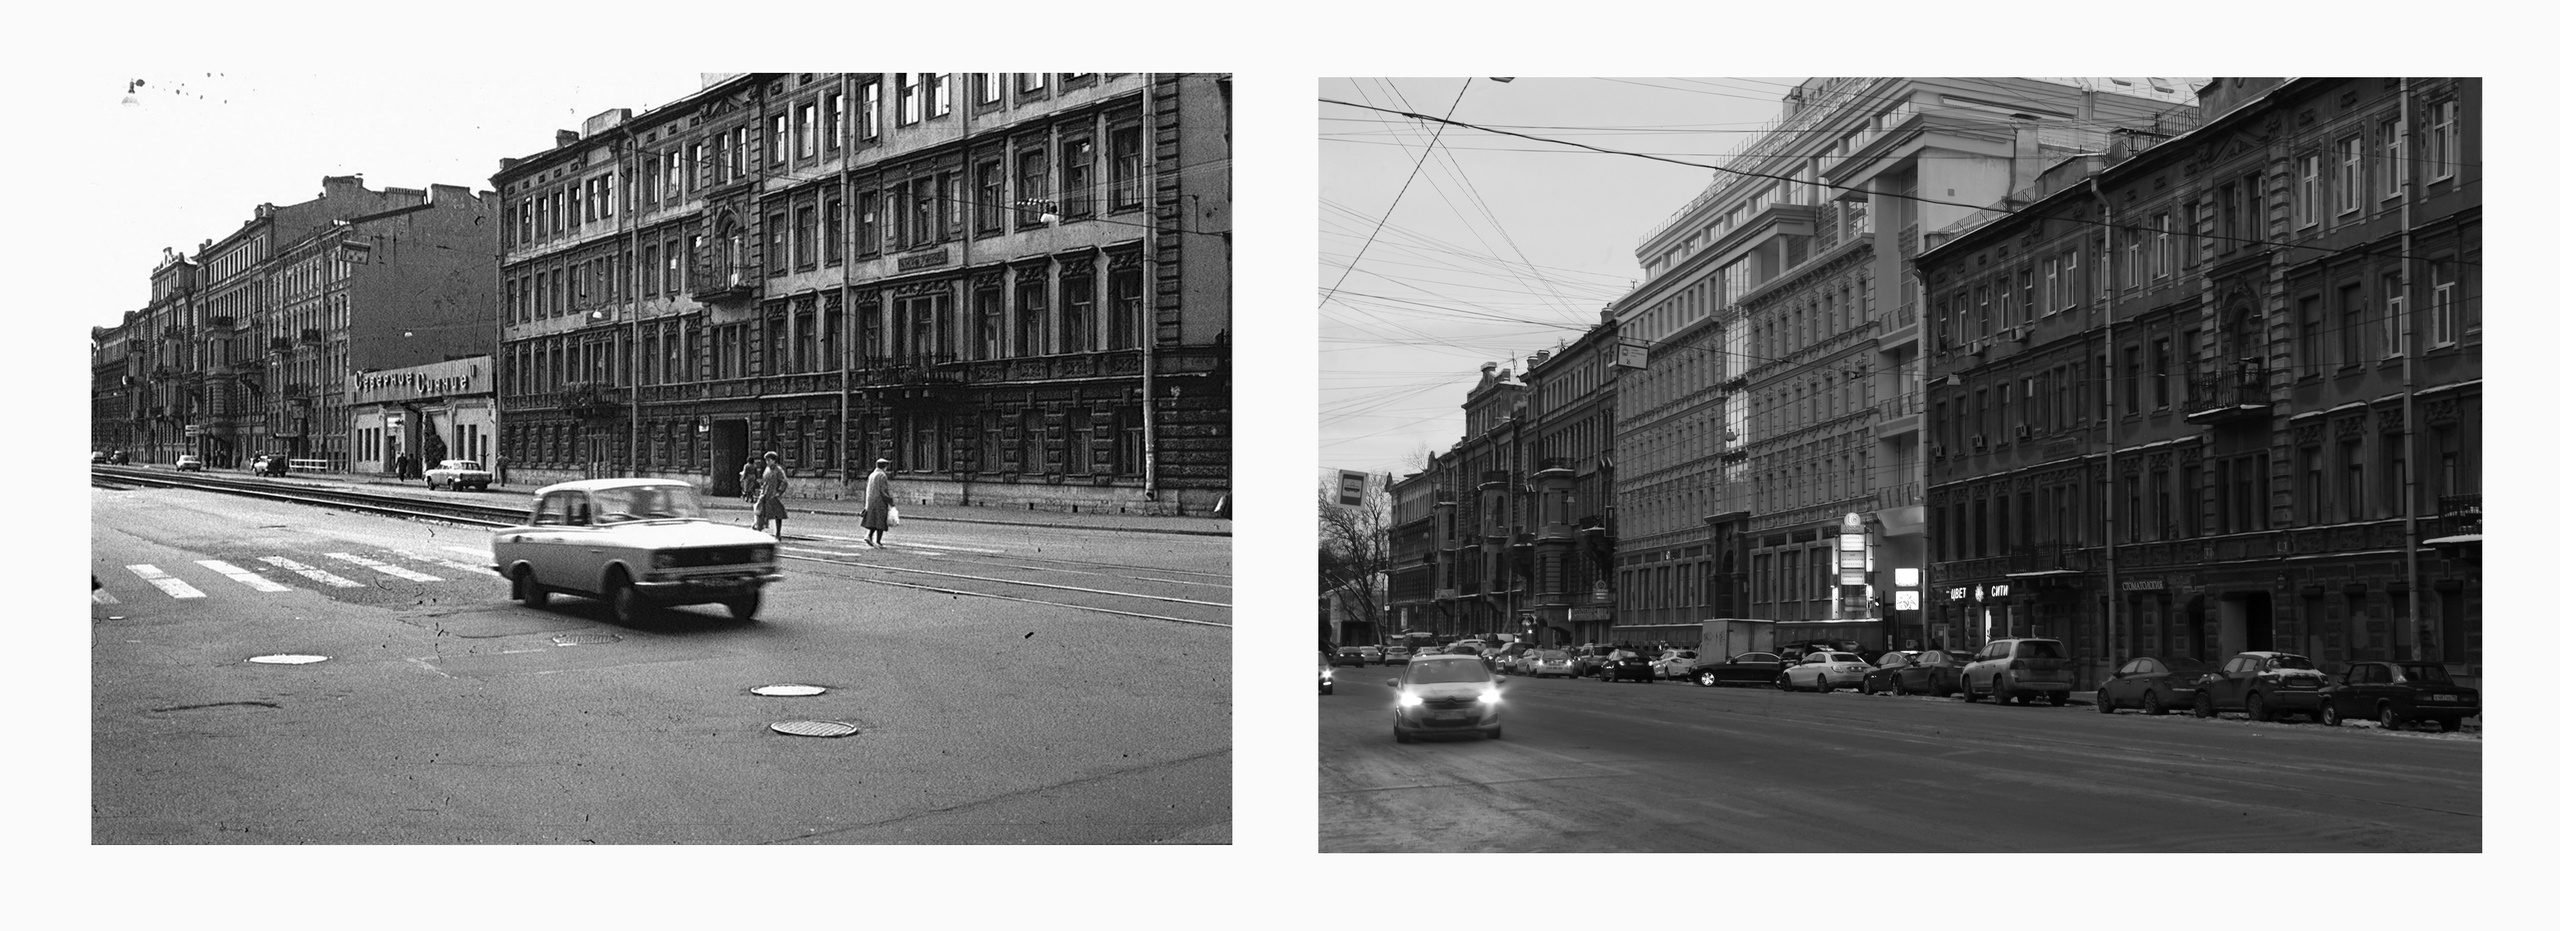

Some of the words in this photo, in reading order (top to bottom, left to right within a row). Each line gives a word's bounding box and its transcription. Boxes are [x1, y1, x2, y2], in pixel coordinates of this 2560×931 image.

[2122, 581, 2164, 591] СТОМАТОЛОГИЯ
[1951, 587, 1967, 601] ЦВЕТ
[1991, 585, 2009, 597] СИТИ
